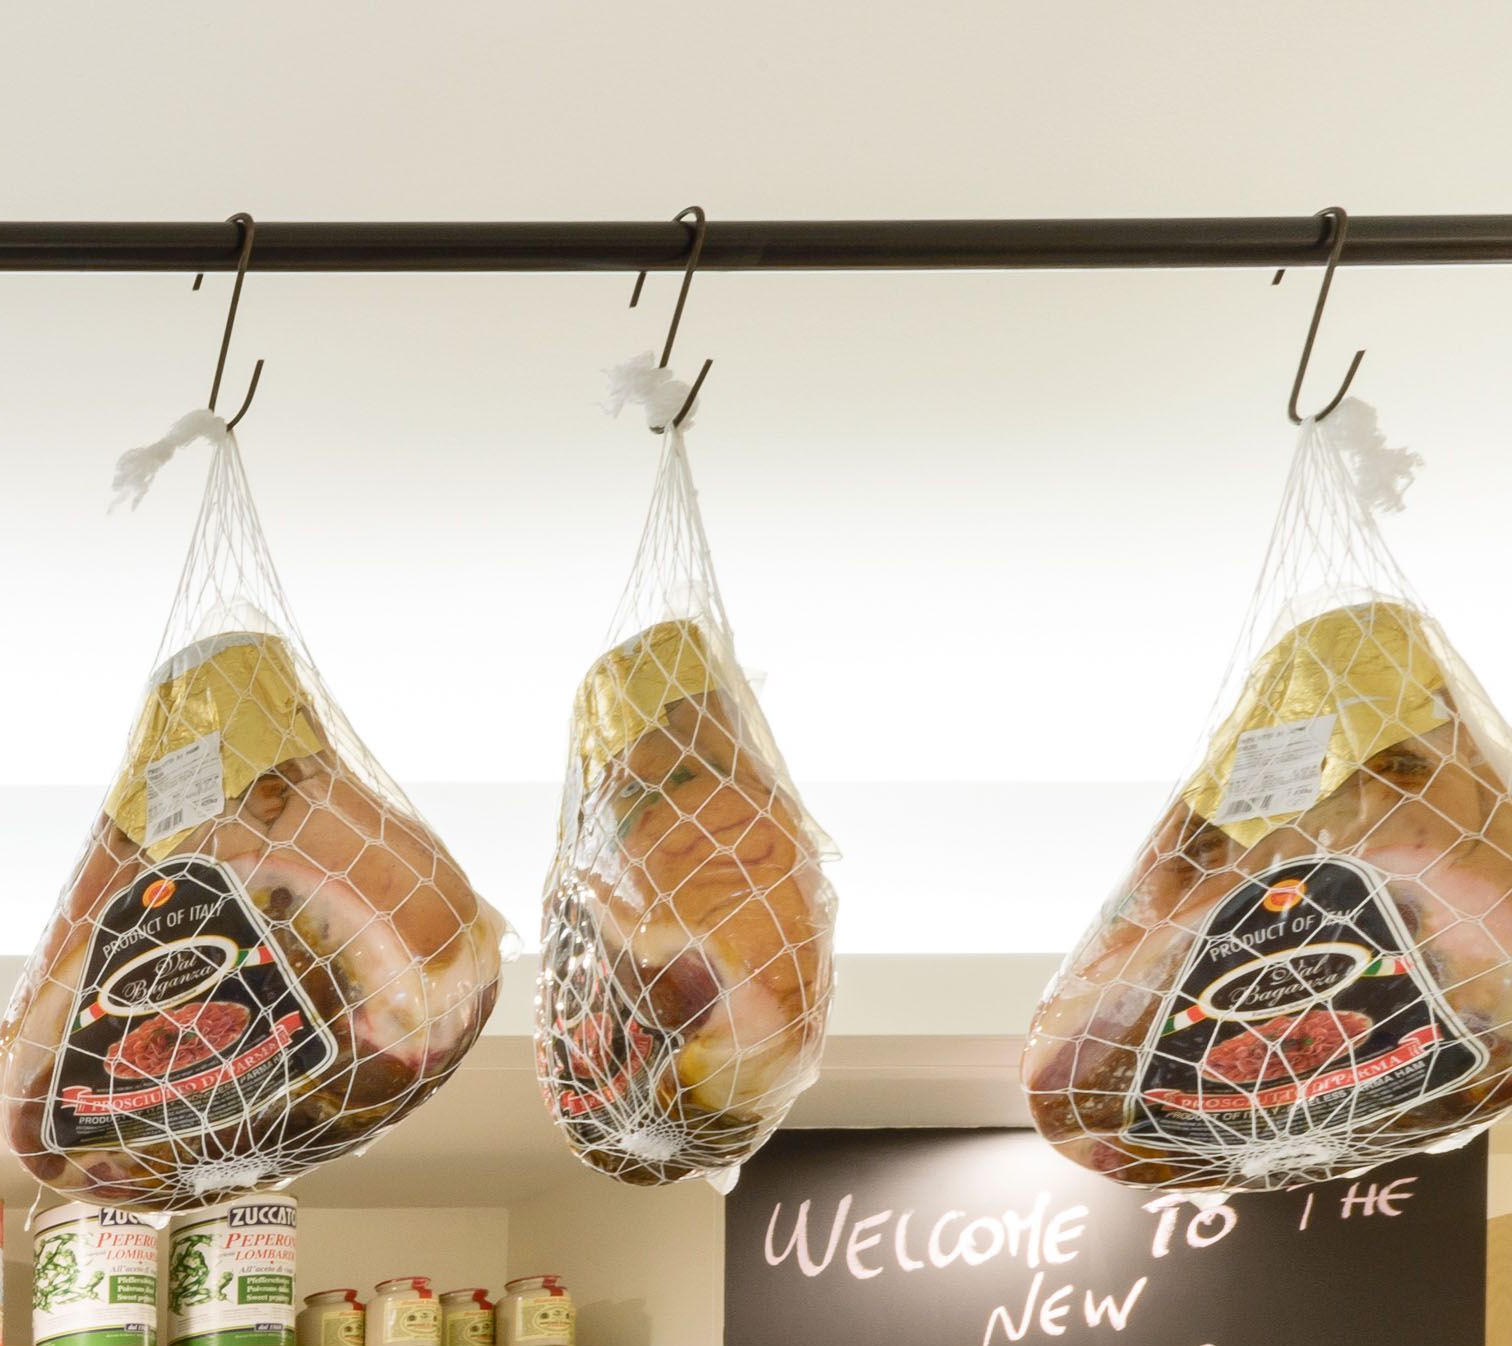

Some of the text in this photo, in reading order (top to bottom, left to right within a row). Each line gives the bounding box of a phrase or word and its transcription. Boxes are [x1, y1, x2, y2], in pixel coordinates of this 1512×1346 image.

[103, 901, 223, 958] PRODUCT OF ITALY
[1210, 915, 1315, 961] PRODUCT OF
[123, 965, 213, 1001] Baganza
[154, 953, 196, 978] Val
[1271, 959, 1323, 986] Val
[1230, 971, 1339, 1008] Baganza
[763, 1177, 1418, 1279] WELCOME TO THE
[983, 1271, 1148, 1346] NEW
